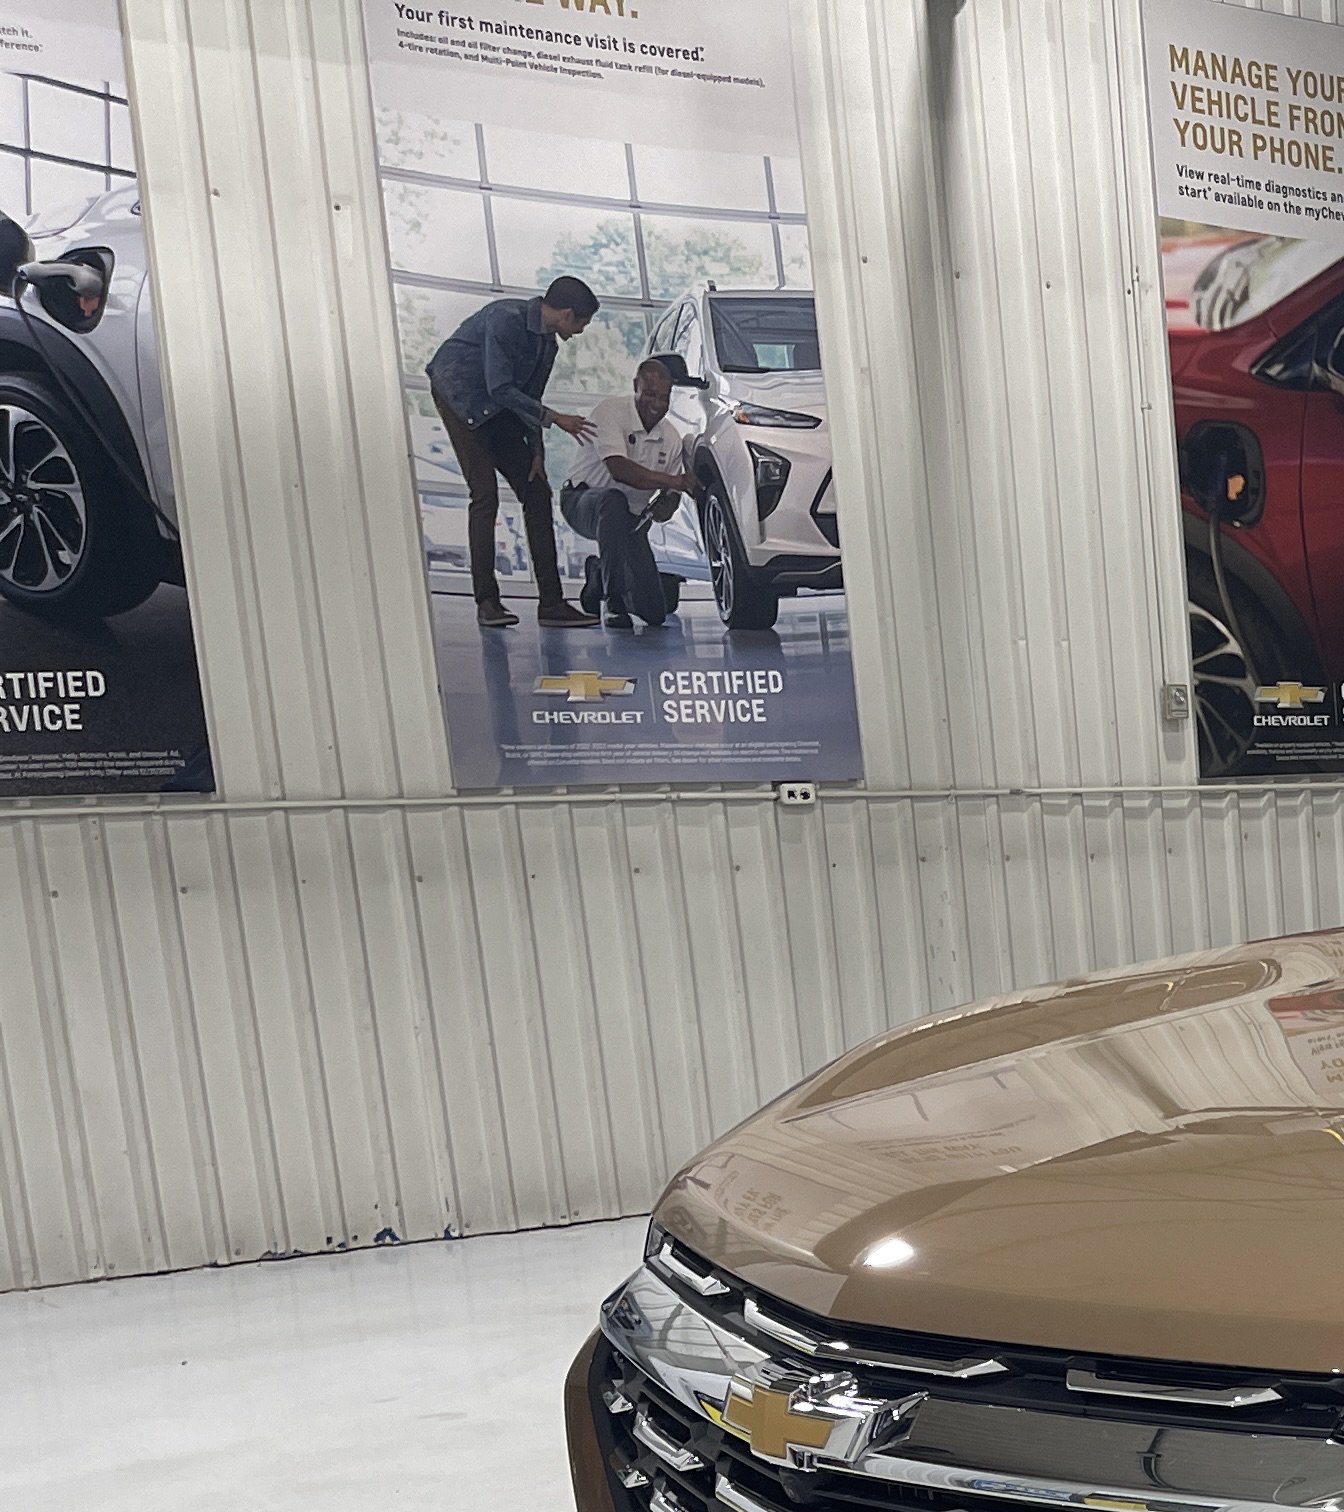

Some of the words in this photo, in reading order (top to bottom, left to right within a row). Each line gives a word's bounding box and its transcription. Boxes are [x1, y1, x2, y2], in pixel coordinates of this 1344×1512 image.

[394, 2, 433, 23] Your
[437, 11, 475, 31] first
[479, 19, 582, 46] maintenance
[585, 33, 619, 52] visit
[623, 37, 635, 54] is
[1169, 43, 1279, 93] MANAGE
[1170, 80, 1281, 129] VEHICLE
[1173, 117, 1244, 158] YOUR
[1253, 133, 1344, 175] PHONE.
[1176, 163, 1205, 181] View
[1207, 171, 1262, 192] real-time
[1264, 180, 1328, 202] diagnostics
[1214, 190, 1264, 210] available
[1267, 201, 1281, 212] on
[1283, 201, 1302, 215] the
[659, 670, 784, 695] CERTIFIED
[532, 710, 645, 724] CHEVROLET
[663, 699, 767, 723] SERVICE
[1253, 715, 1330, 726] CHEVROLET
